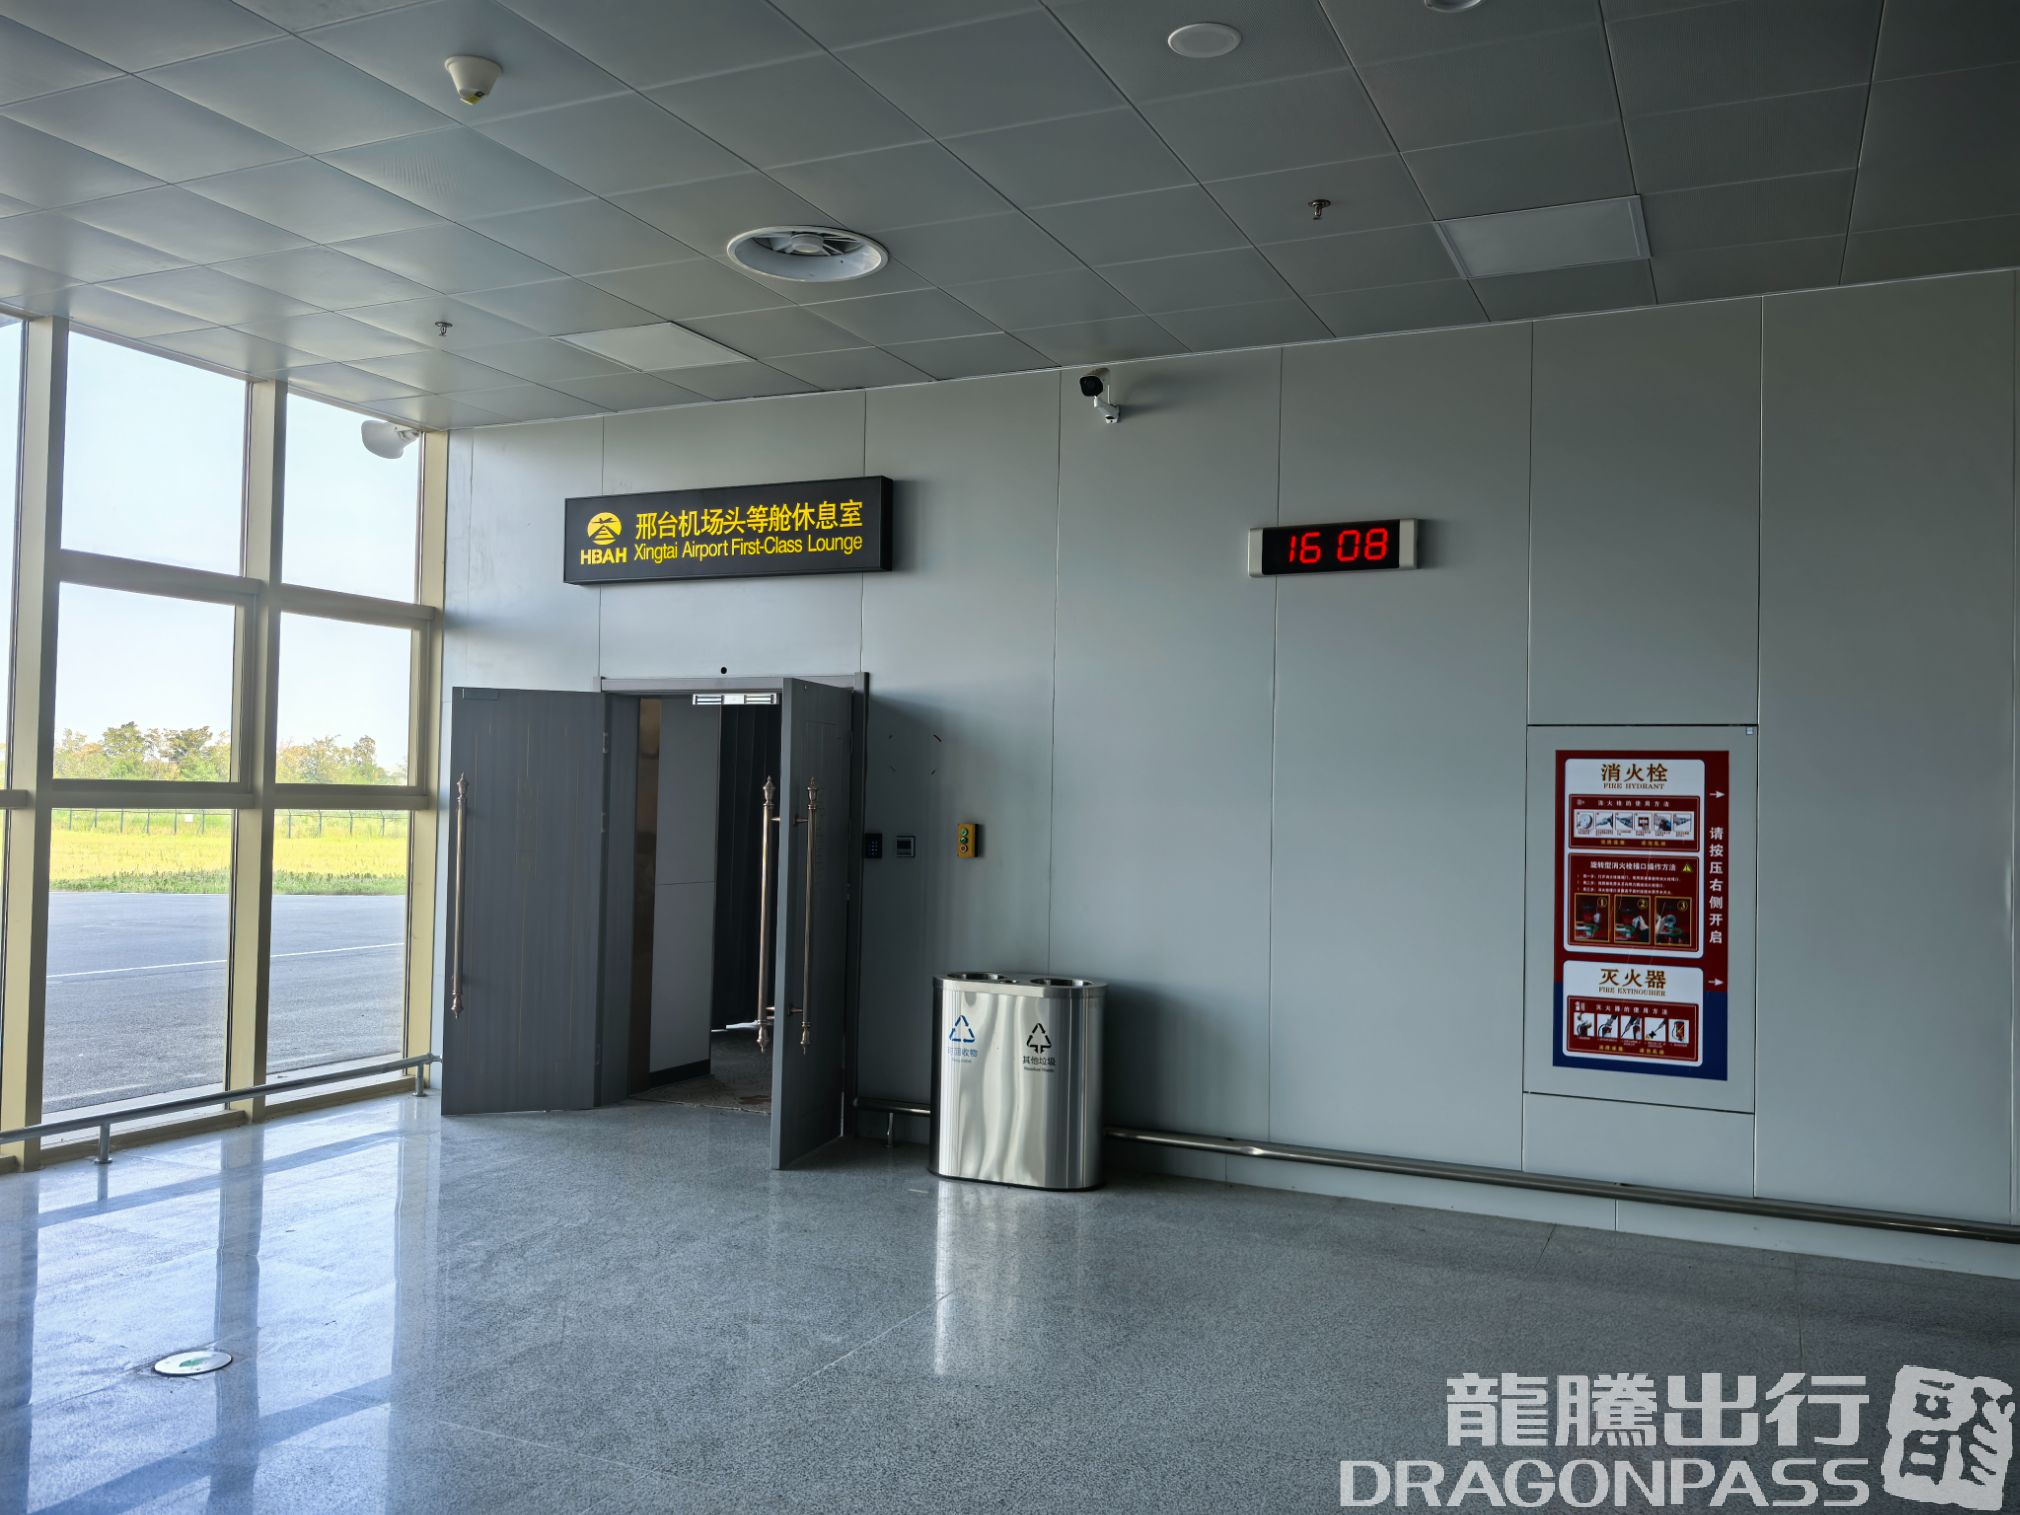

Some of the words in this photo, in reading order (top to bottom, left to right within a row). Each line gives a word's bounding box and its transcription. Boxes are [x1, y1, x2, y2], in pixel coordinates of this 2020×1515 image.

[635, 499, 863, 540] 邢台机场头等舱休息室
[580, 546, 627, 565] HBAH
[634, 541, 678, 564] Xingtai
[682, 539, 728, 562] Airport
[731, 537, 803, 556] First-Class
[808, 533, 863, 555] Lounge
[1289, 532, 1321, 564] 16
[1337, 528, 1389, 562] 08
[1601, 763, 1668, 782] 消火栓
[1709, 827, 1724, 944] 请按压右侧开启
[1598, 969, 1667, 989] 灭火器
[1598, 986, 1615, 994] FIRE
[1022, 1055, 1056, 1067] 其他垃圾
